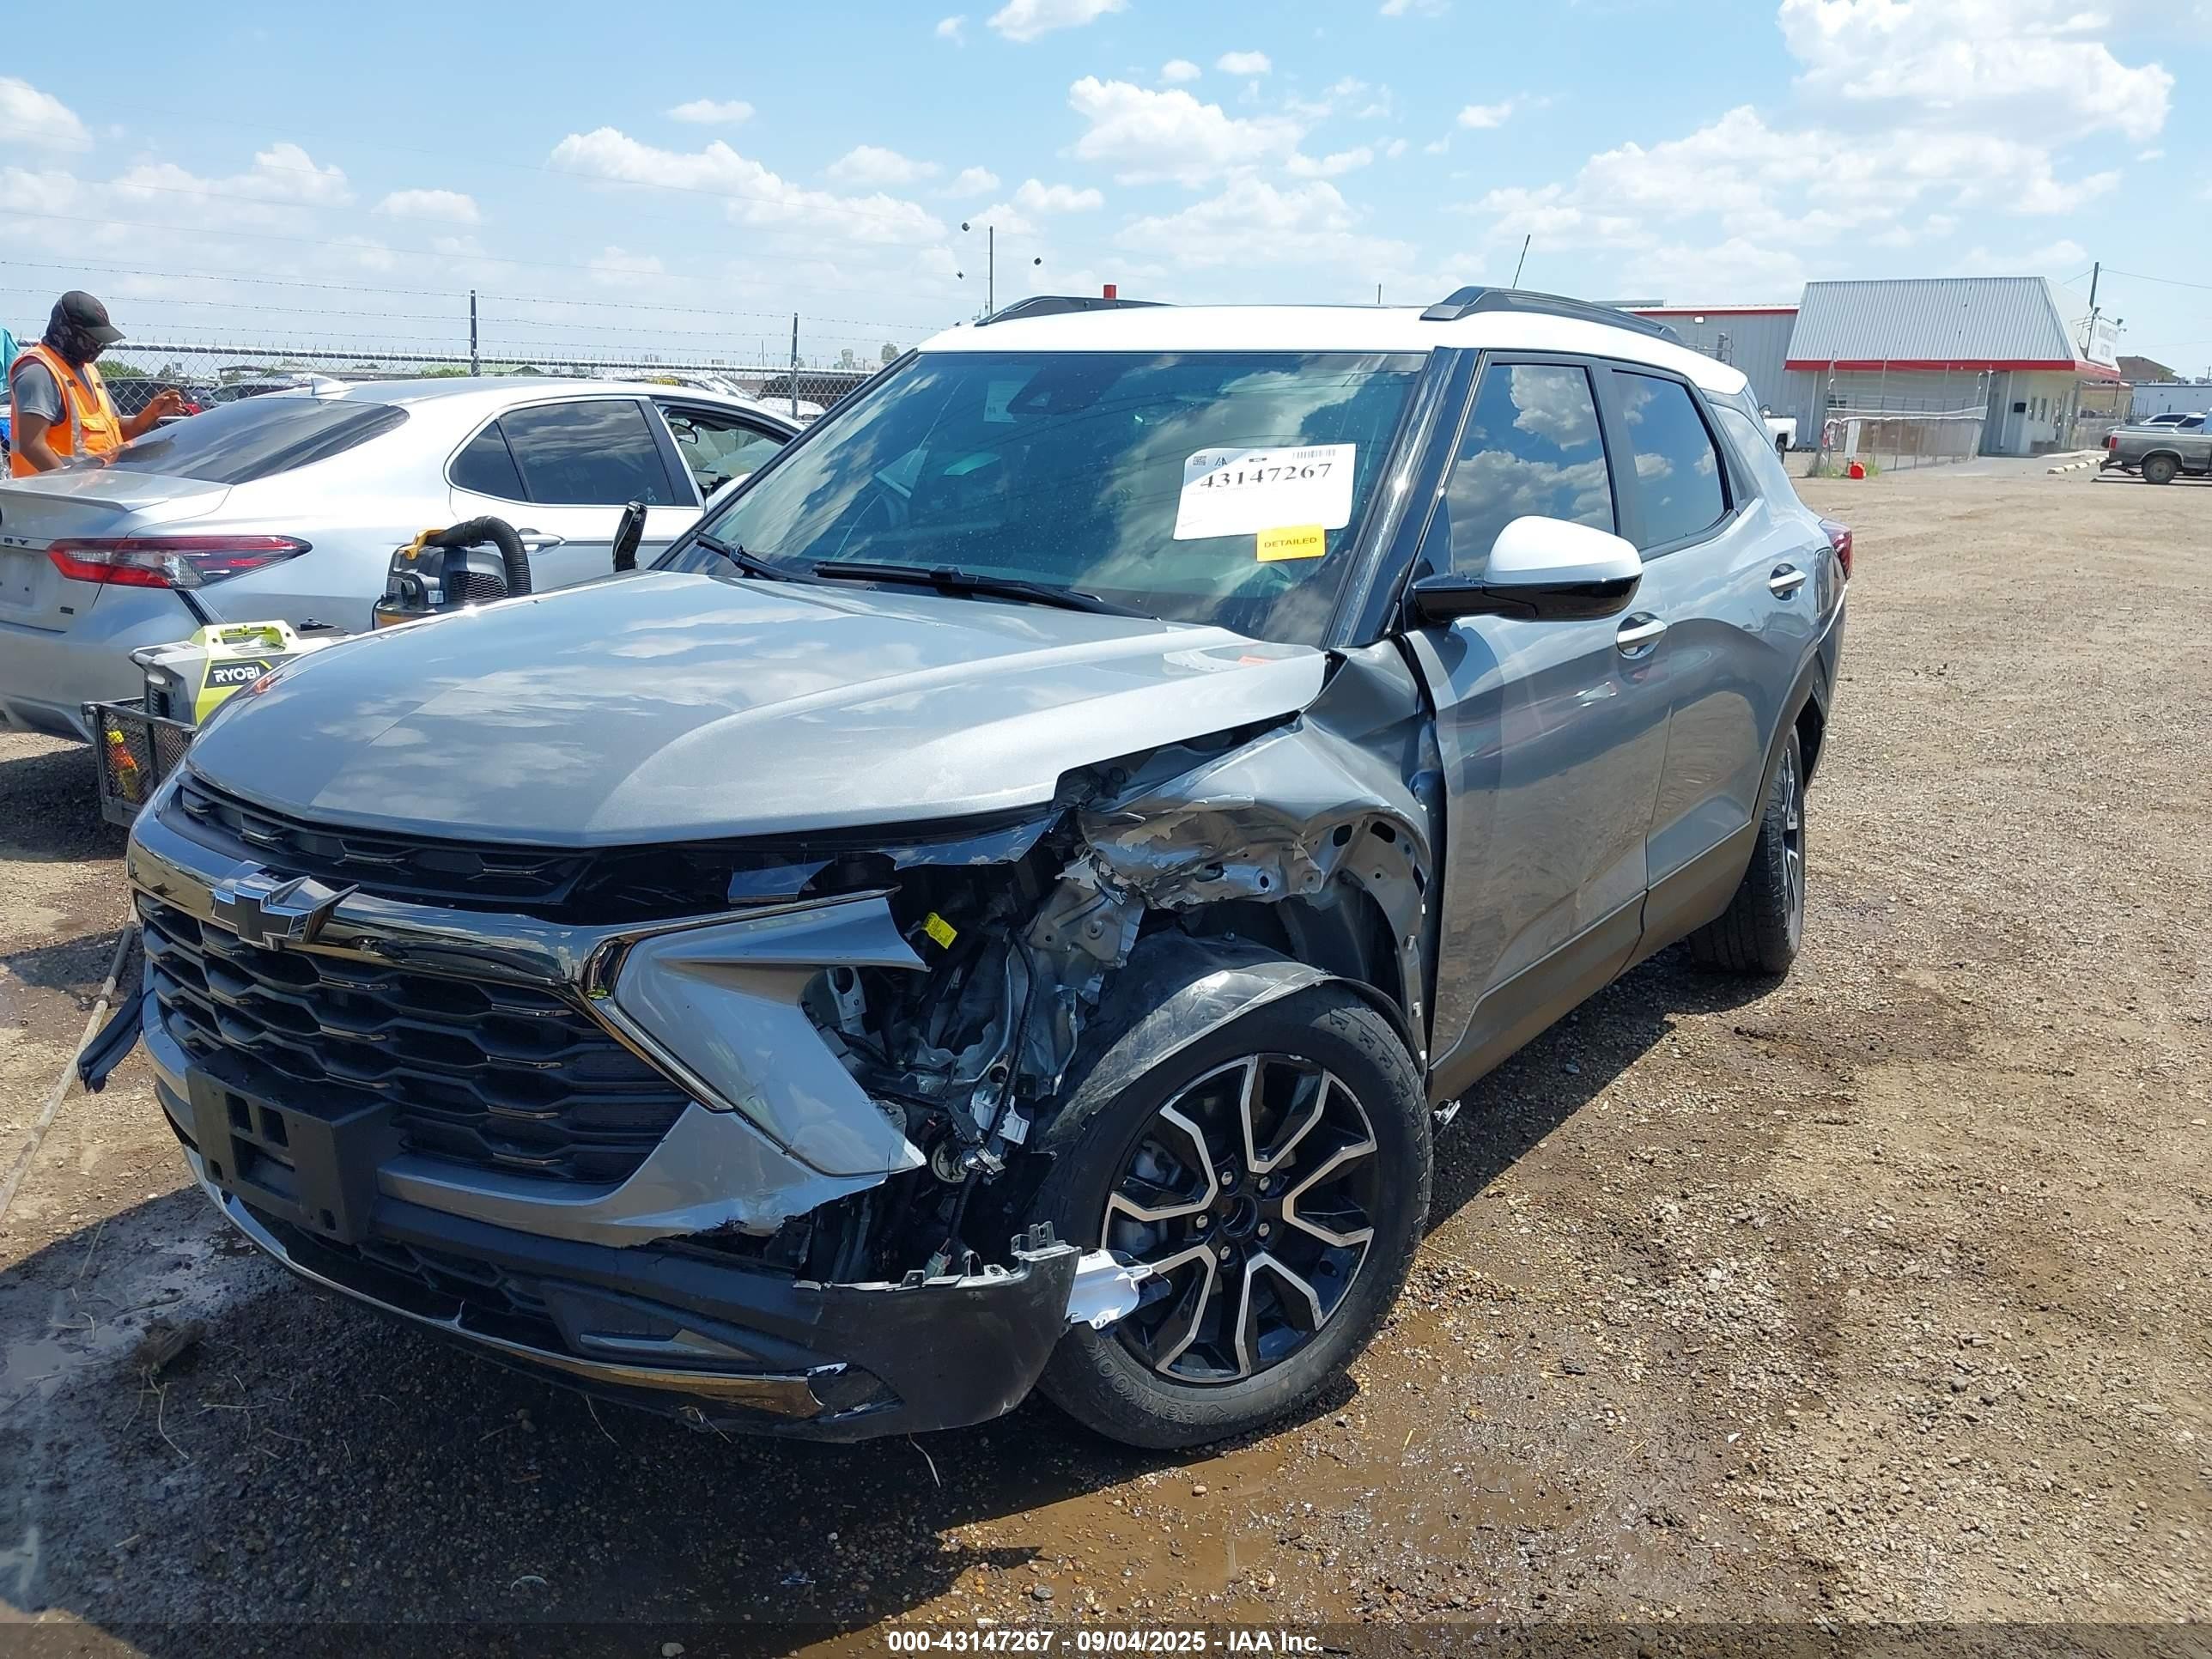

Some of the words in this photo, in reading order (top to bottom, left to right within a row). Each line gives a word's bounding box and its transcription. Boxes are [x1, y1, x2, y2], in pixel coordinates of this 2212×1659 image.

[1200, 462, 1333, 489] 43147267
[1264, 537, 1318, 549] DETAILED
[212, 665, 261, 683] RYOBI
